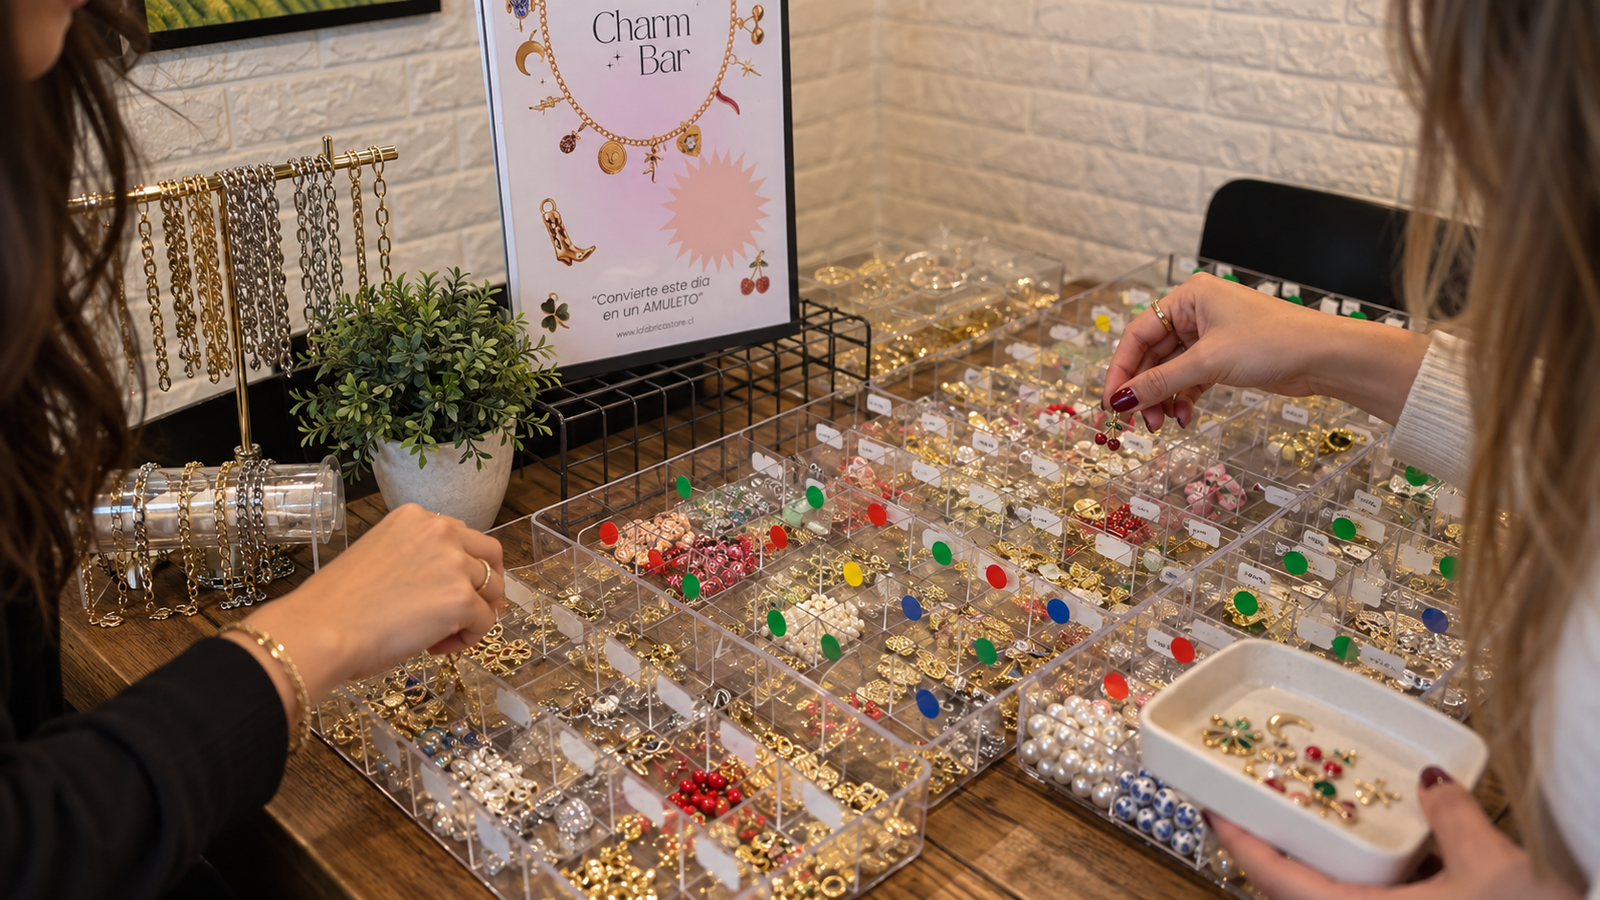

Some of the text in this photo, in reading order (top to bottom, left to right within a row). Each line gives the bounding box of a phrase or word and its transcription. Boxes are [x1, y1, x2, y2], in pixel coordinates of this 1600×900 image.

[592, 9, 691, 44] Charm
[639, 44, 691, 76] Bar
[661, 280, 688, 295] este
[602, 308, 619, 321] en
[623, 304, 639, 318] un
